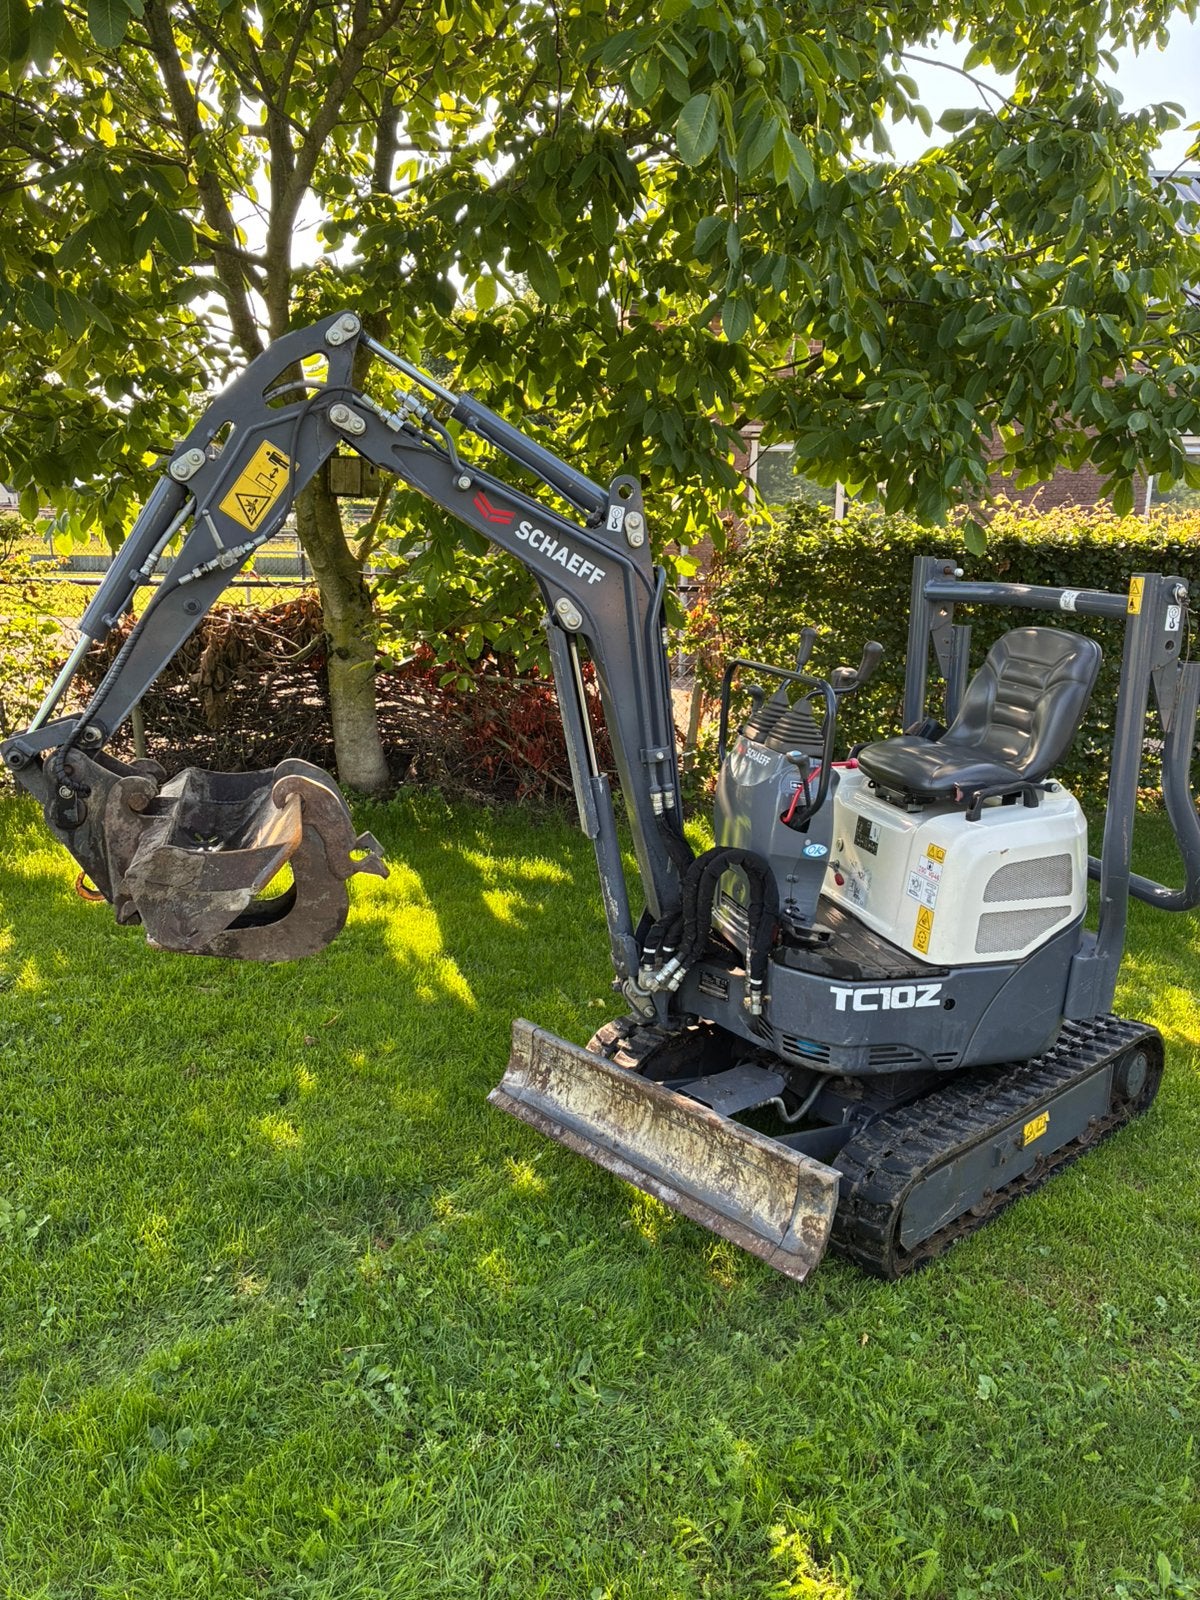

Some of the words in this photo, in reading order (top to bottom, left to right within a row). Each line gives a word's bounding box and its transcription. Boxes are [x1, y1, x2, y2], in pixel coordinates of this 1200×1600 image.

[514, 520, 606, 585] SCHAEFF
[745, 747, 771, 766] SCHAEFF
[807, 846, 823, 855] OK
[829, 983, 943, 1012] TC10Z
